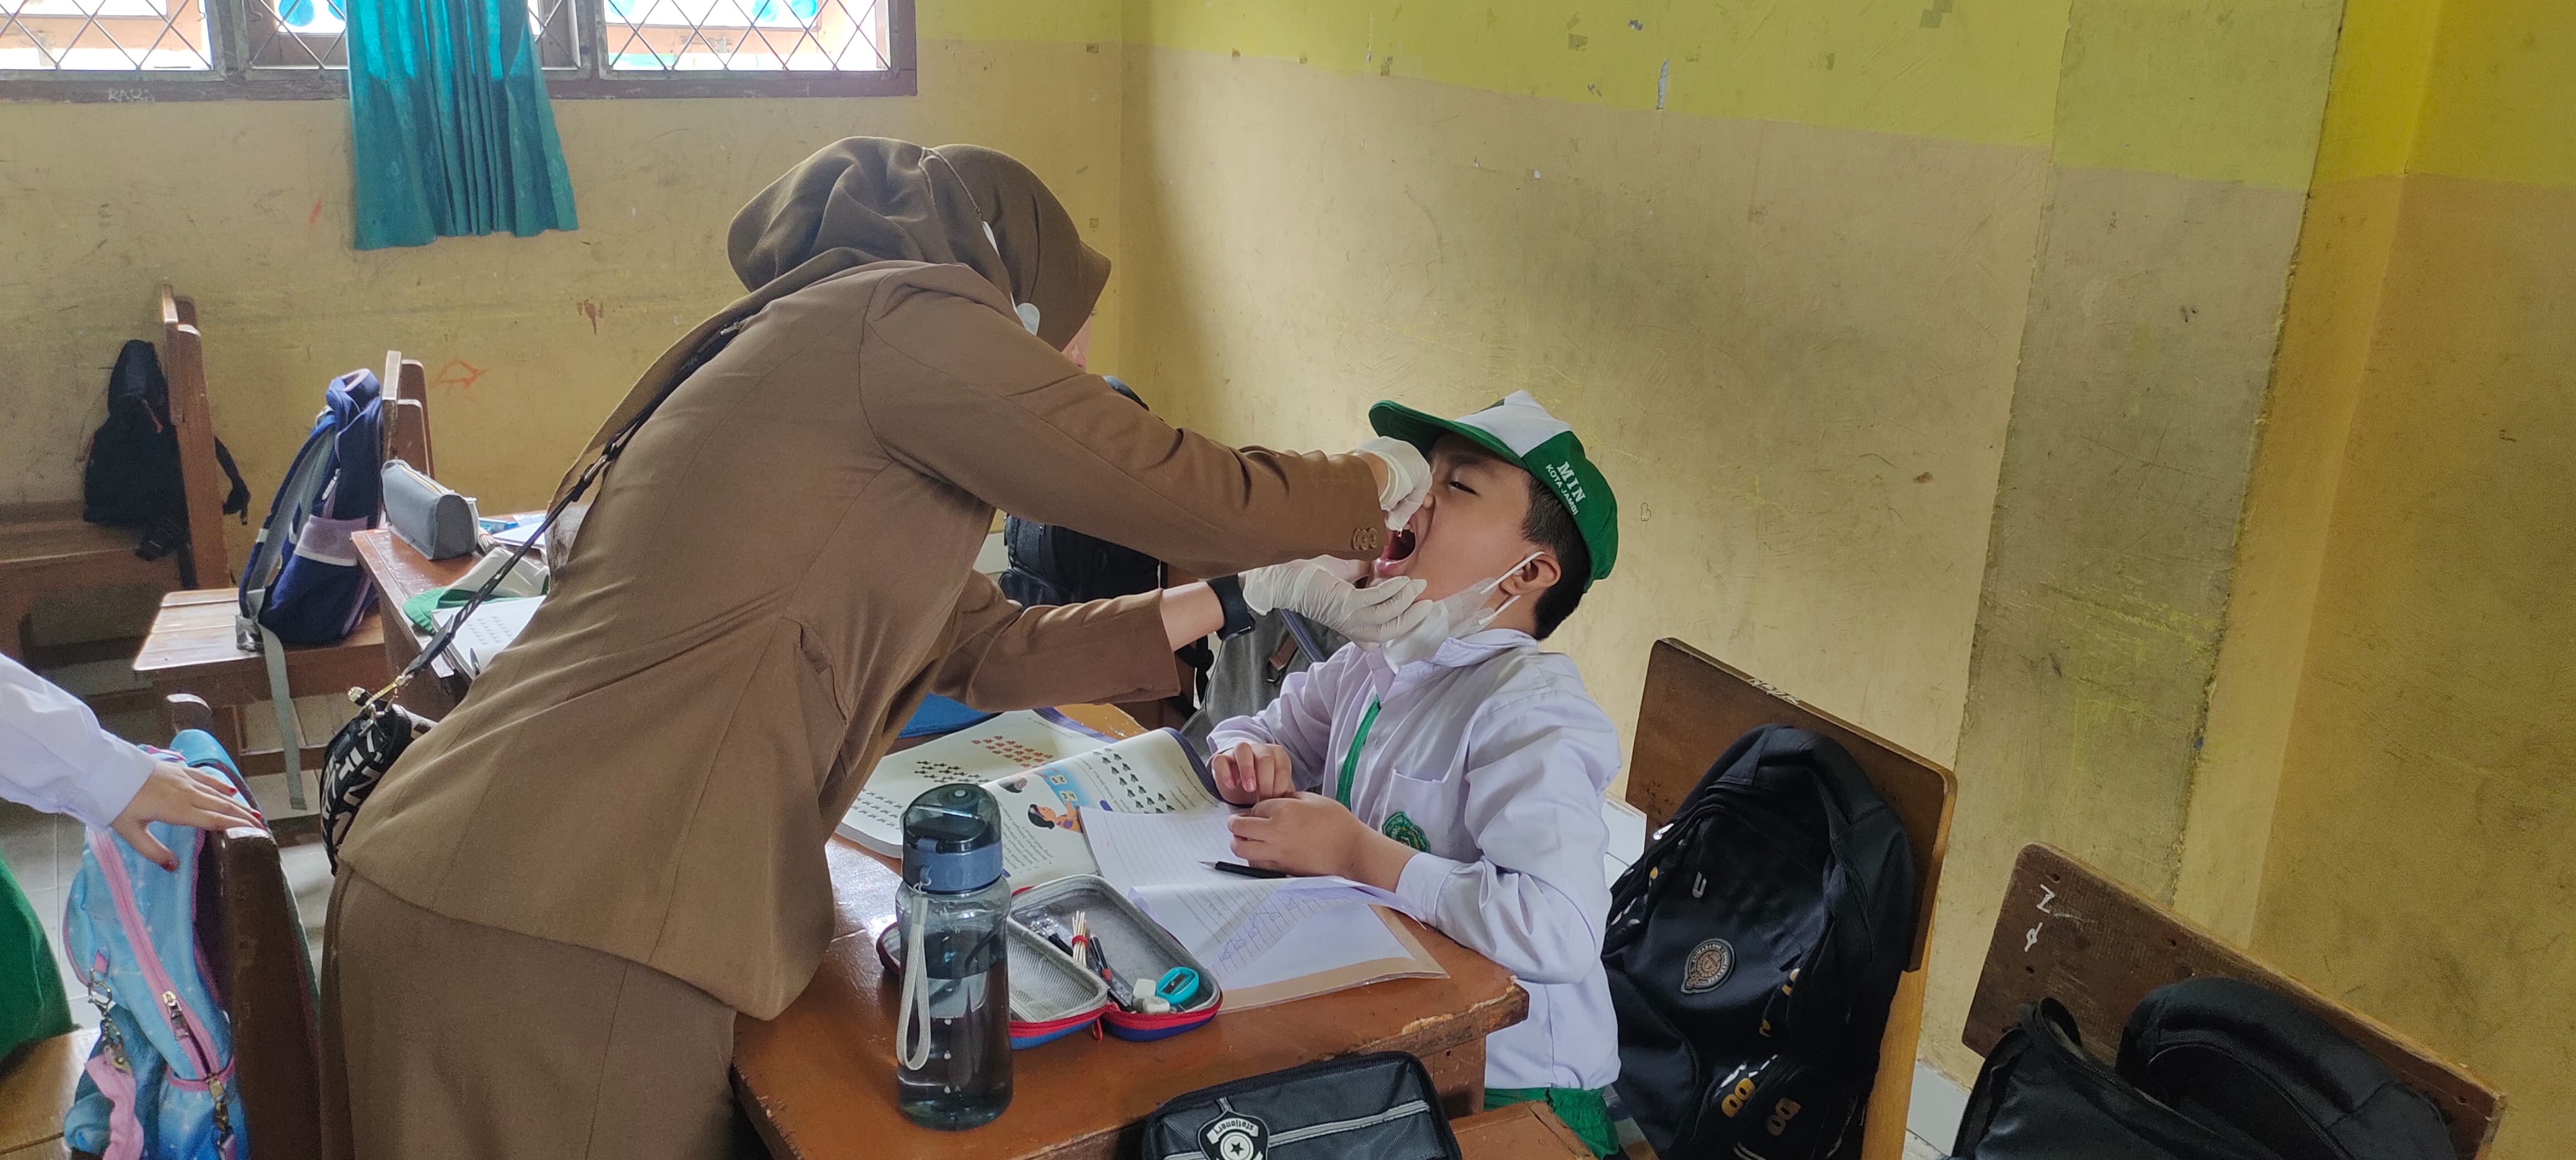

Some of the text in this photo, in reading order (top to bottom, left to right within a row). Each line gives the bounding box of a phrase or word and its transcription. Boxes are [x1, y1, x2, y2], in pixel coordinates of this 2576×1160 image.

[1546, 464, 1578, 515] KOTA JAMBI
[1557, 461, 1586, 503] MIN
[1214, 1119, 1255, 1136] stationery
